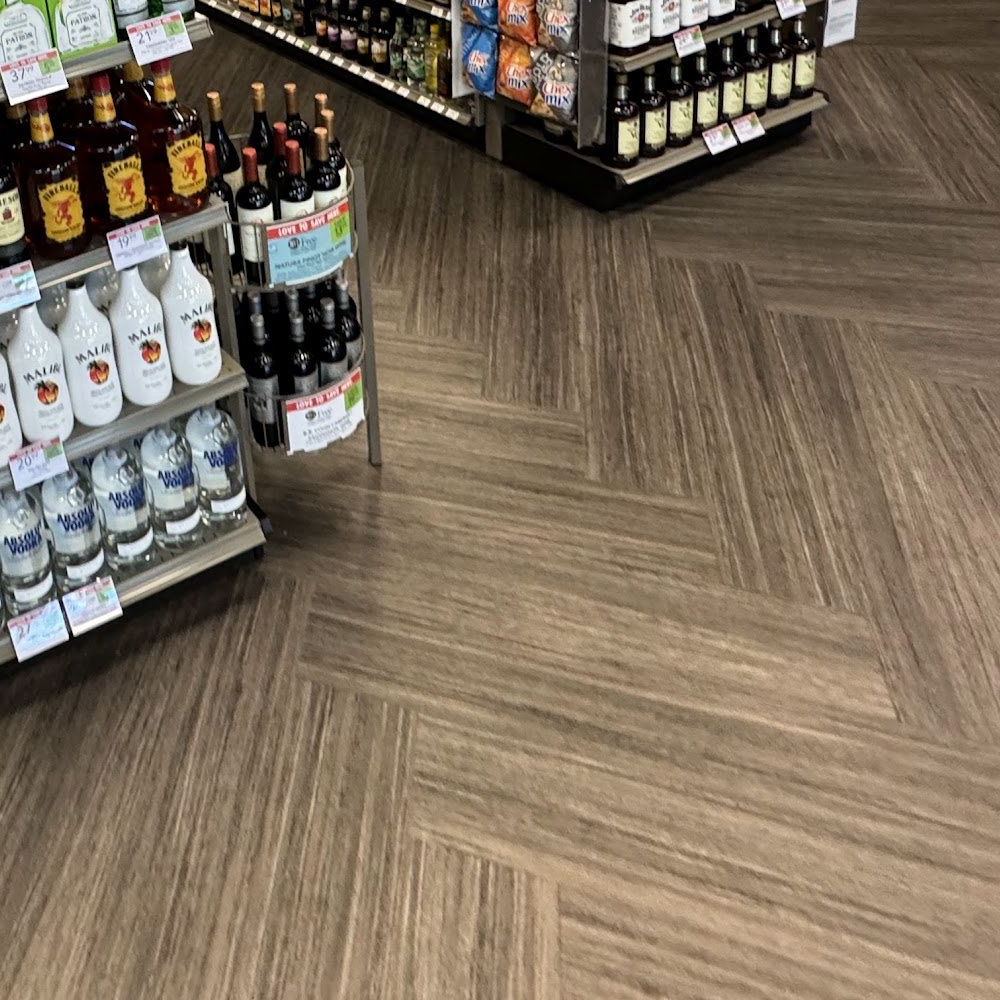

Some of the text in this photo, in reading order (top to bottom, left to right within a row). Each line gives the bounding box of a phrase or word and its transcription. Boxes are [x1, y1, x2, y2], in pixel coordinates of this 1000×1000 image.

[506, 0, 528, 16] Chex
[507, 14, 528, 25] mix
[544, 10, 570, 26] Chex
[546, 24, 567, 36] mix
[506, 65, 532, 81] Chex
[507, 77, 529, 89] mix
[542, 81, 572, 97] Chex
[545, 95, 570, 107] mix
[278, 225, 296, 237] LOVE
[299, 222, 308, 233] TO
[311, 216, 325, 228] SAVE
[327, 208, 340, 220] HERE
[296, 399, 313, 411] LOVE
[316, 396, 324, 405] TO
